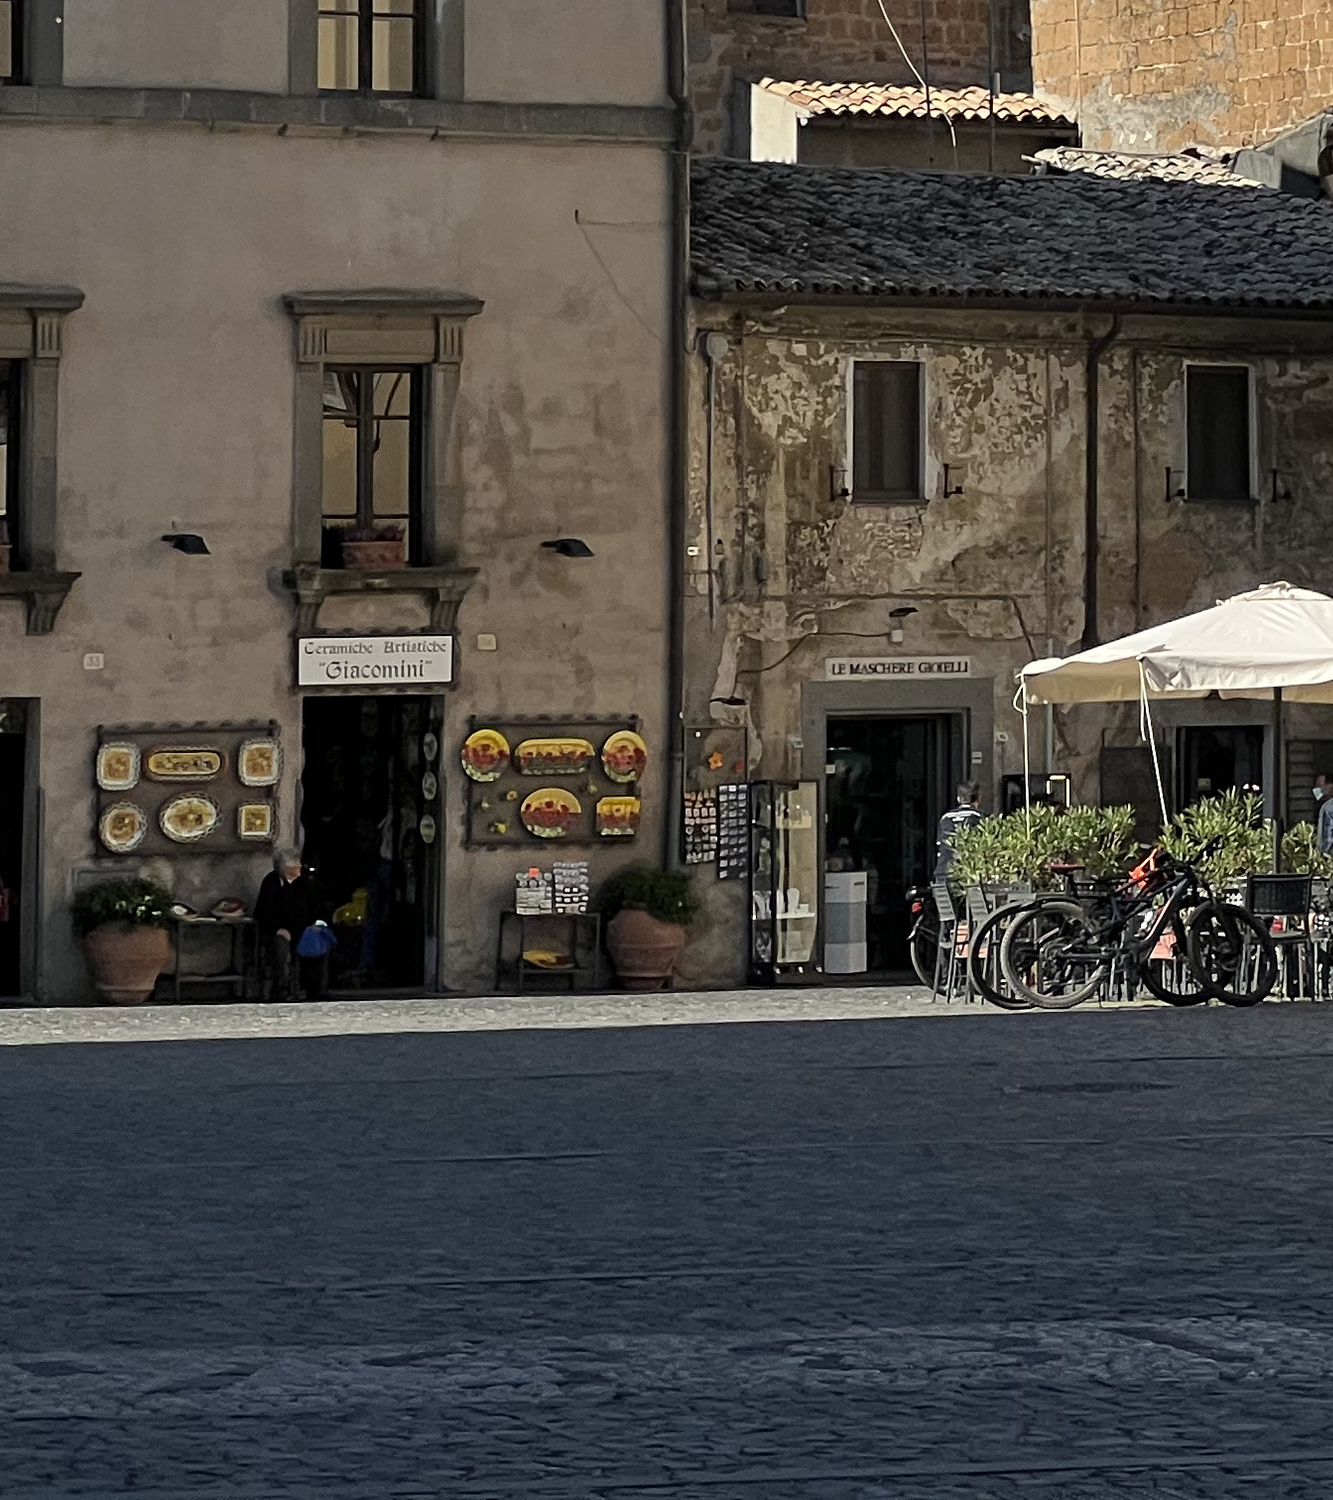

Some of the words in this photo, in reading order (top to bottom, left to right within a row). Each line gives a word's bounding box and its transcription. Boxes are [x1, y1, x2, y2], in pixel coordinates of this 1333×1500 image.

[304, 642, 373, 655] Ceramiche
[384, 640, 447, 654] Artistiche
[832, 663, 846, 675] LE
[849, 662, 915, 675] MASCHERE
